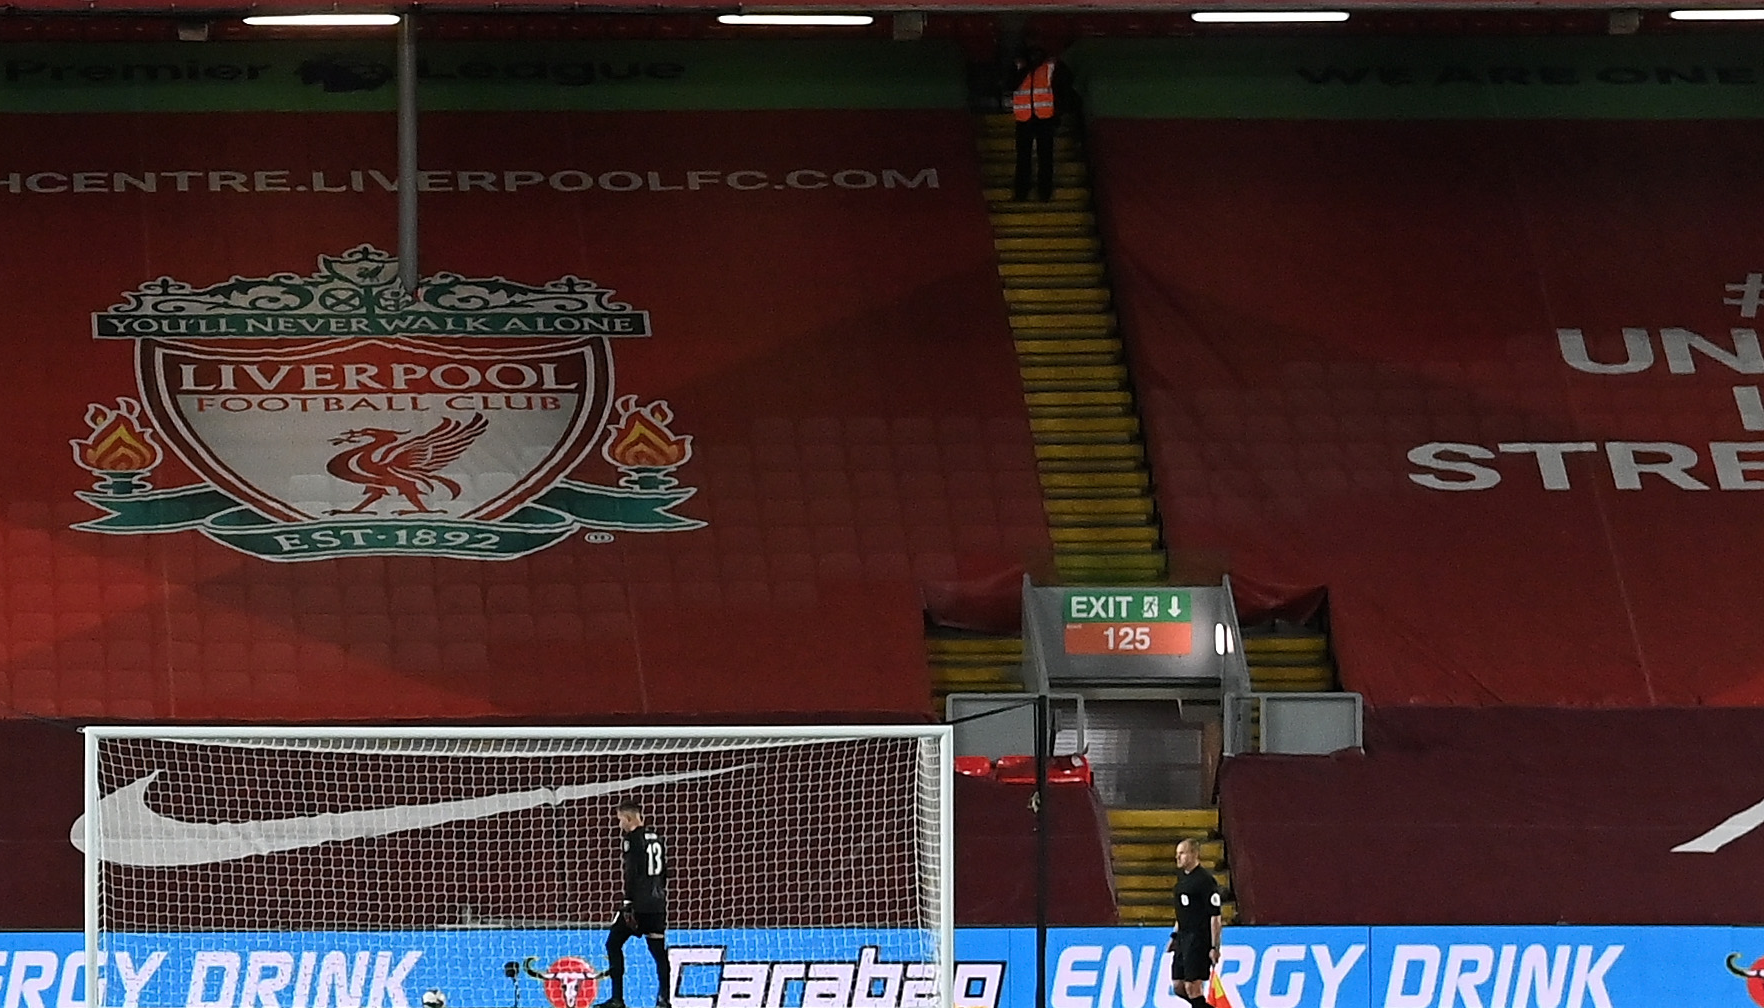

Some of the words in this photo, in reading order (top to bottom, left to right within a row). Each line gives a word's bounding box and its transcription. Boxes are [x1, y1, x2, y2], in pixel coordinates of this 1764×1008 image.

[5, 58, 273, 82] Premier
[417, 57, 686, 86] League
[1297, 66, 1415, 85] WE
[1437, 66, 1580, 85] ARE
[1595, 66, 1756, 86] ONE
[107, 317, 236, 334] YOU'LL
[245, 317, 373, 333] NEVER
[379, 316, 490, 332] WALK
[500, 316, 634, 332] ALONE
[178, 363, 579, 392] LIVERPOOL
[195, 395, 429, 413] FOOTBALL
[444, 394, 561, 412] CLUB
[1071, 595, 1134, 619] EXIT
[1103, 626, 1151, 651] 125
[646, 841, 663, 877] 13
